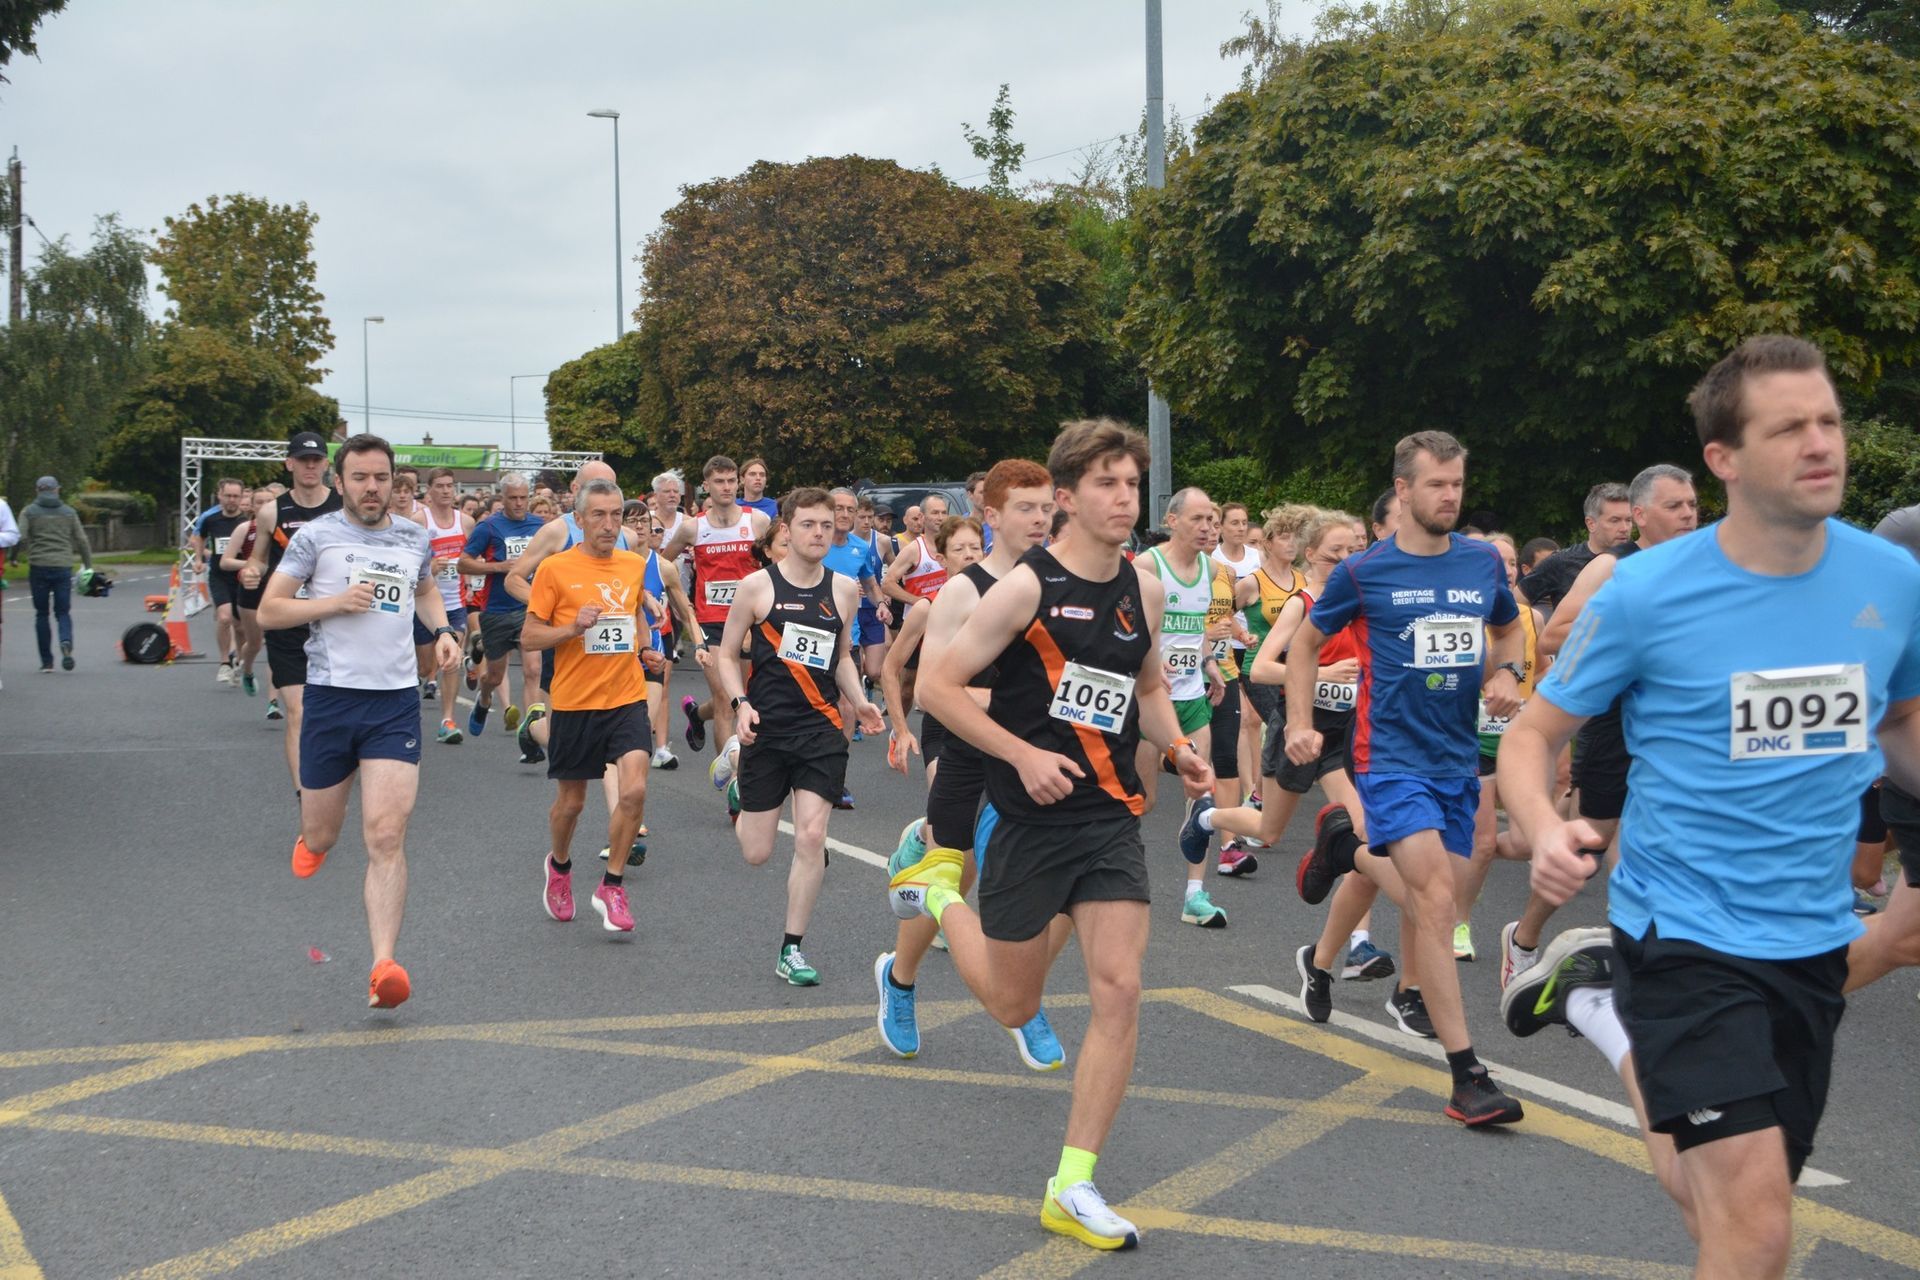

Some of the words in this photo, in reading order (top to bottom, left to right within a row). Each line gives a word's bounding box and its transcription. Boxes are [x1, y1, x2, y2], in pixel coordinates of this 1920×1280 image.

[706, 545, 737, 554] GOWRAN
[738, 544, 749, 552] AC
[359, 580, 401, 602] 60
[711, 588, 737, 599] 777
[1392, 589, 1435, 599] HERITAGE
[1447, 590, 1483, 605] DNG
[1392, 597, 1415, 606] CREDIT
[1415, 596, 1436, 604] UNION
[599, 628, 623, 642] 43
[795, 636, 819, 656] 81
[1427, 632, 1473, 653] 139
[785, 650, 805, 662] DNG
[1168, 654, 1197, 668] 648
[1425, 655, 1449, 665] DNG
[1057, 680, 1127, 716] 1062
[1318, 683, 1353, 701] 600
[1313, 699, 1332, 708] DNG
[1059, 705, 1086, 721] DNG
[1735, 691, 1861, 733] 1092
[1746, 735, 1791, 753] DNG
